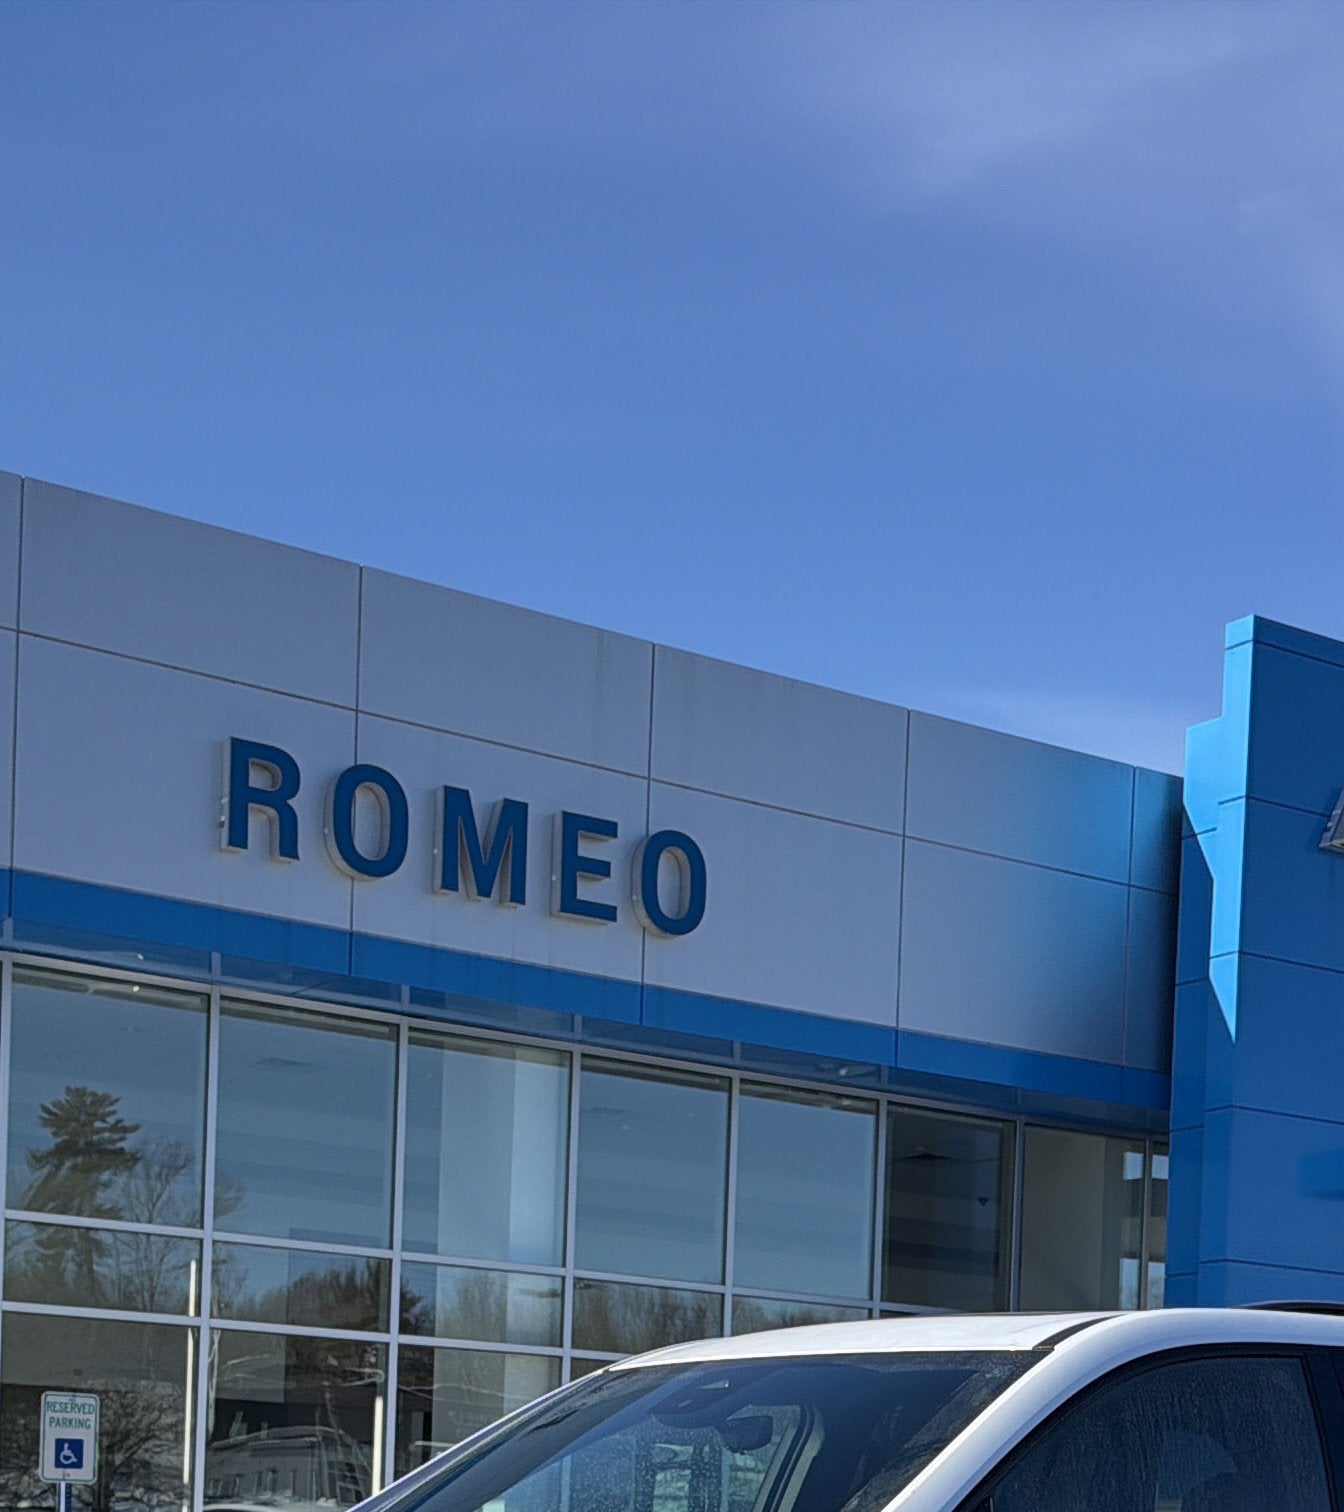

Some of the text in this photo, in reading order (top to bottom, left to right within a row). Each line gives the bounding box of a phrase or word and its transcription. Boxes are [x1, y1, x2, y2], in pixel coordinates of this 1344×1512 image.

[220, 736, 708, 938] ROMEO
[46, 1400, 96, 1415] RESERVED
[49, 1416, 92, 1430] PARKING
